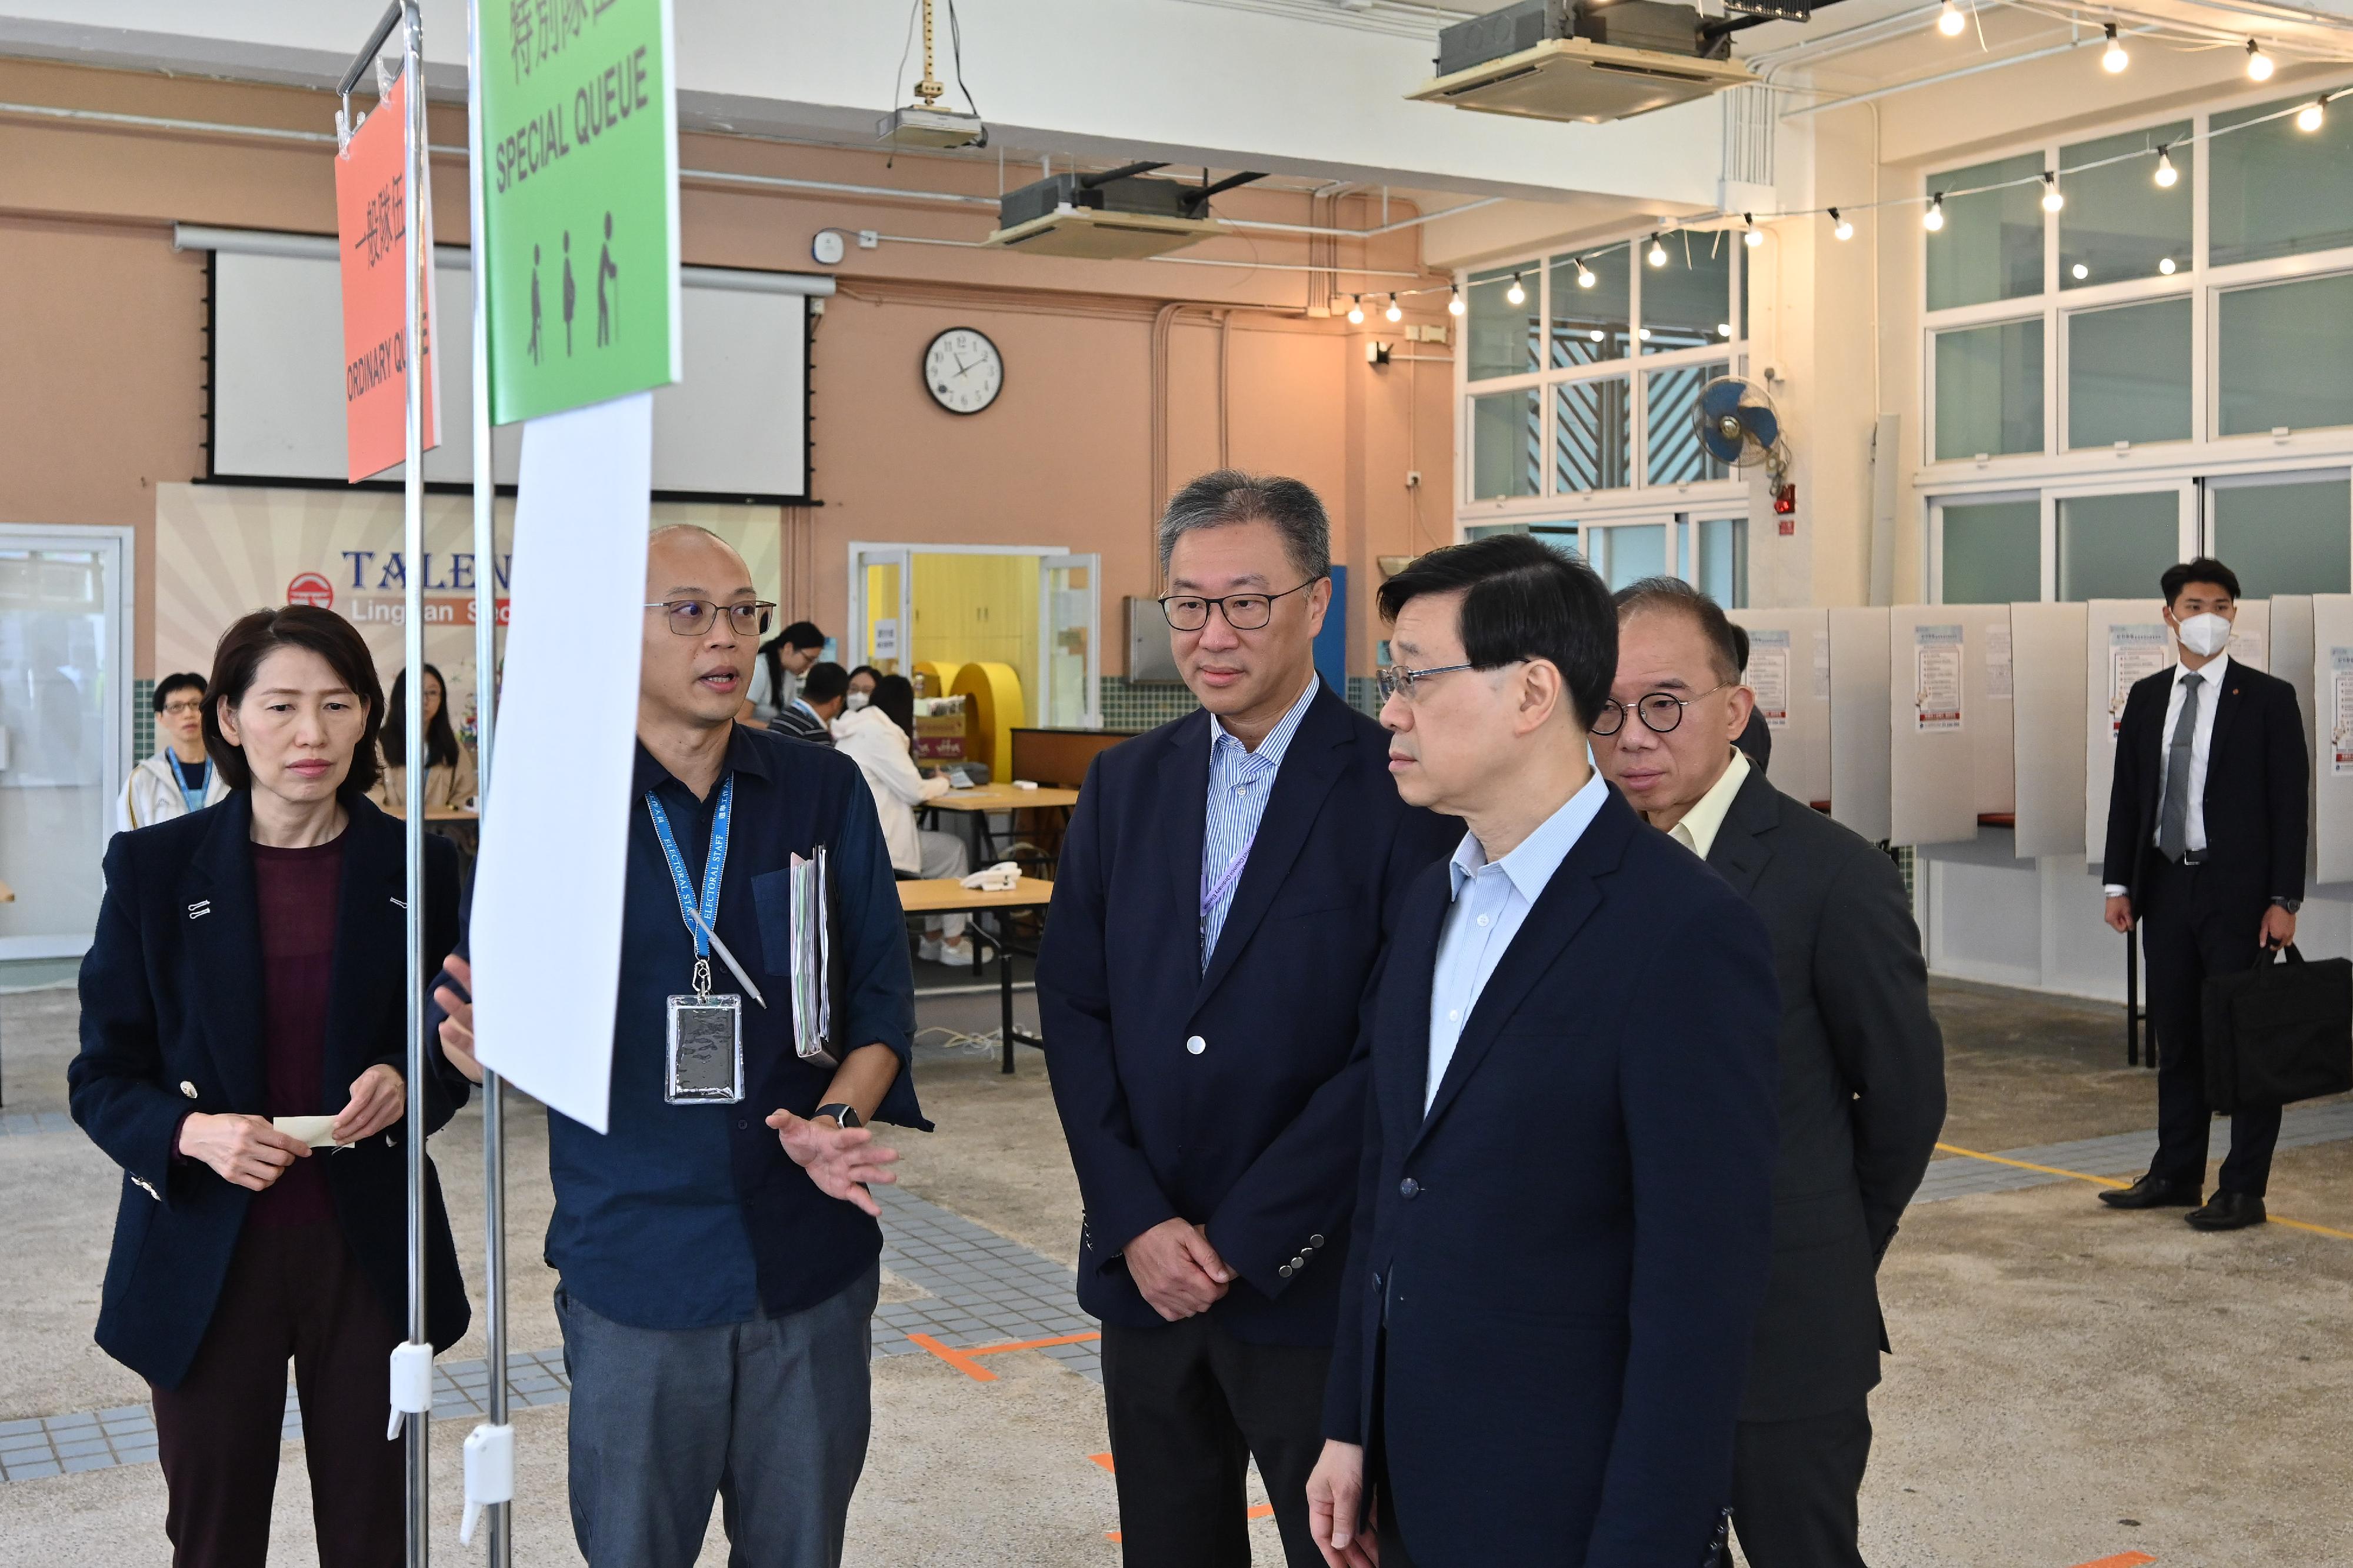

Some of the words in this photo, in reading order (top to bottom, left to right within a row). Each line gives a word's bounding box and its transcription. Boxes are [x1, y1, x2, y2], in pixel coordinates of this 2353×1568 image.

[496, 103, 570, 194] SPECIAL
[575, 43, 648, 145] QUEUE
[355, 172, 406, 270] 一般隊伍
[346, 337, 391, 402] ORDINARY
[394, 311, 429, 373] QUE
[352, 600, 454, 626] Lingan
[663, 839, 689, 892] ELECTORAL
[704, 865, 719, 920] ELECTORAL
[712, 834, 724, 862] STAFF
[1215, 875, 1231, 894] Ordinary
[1229, 858, 1244, 876] Council
